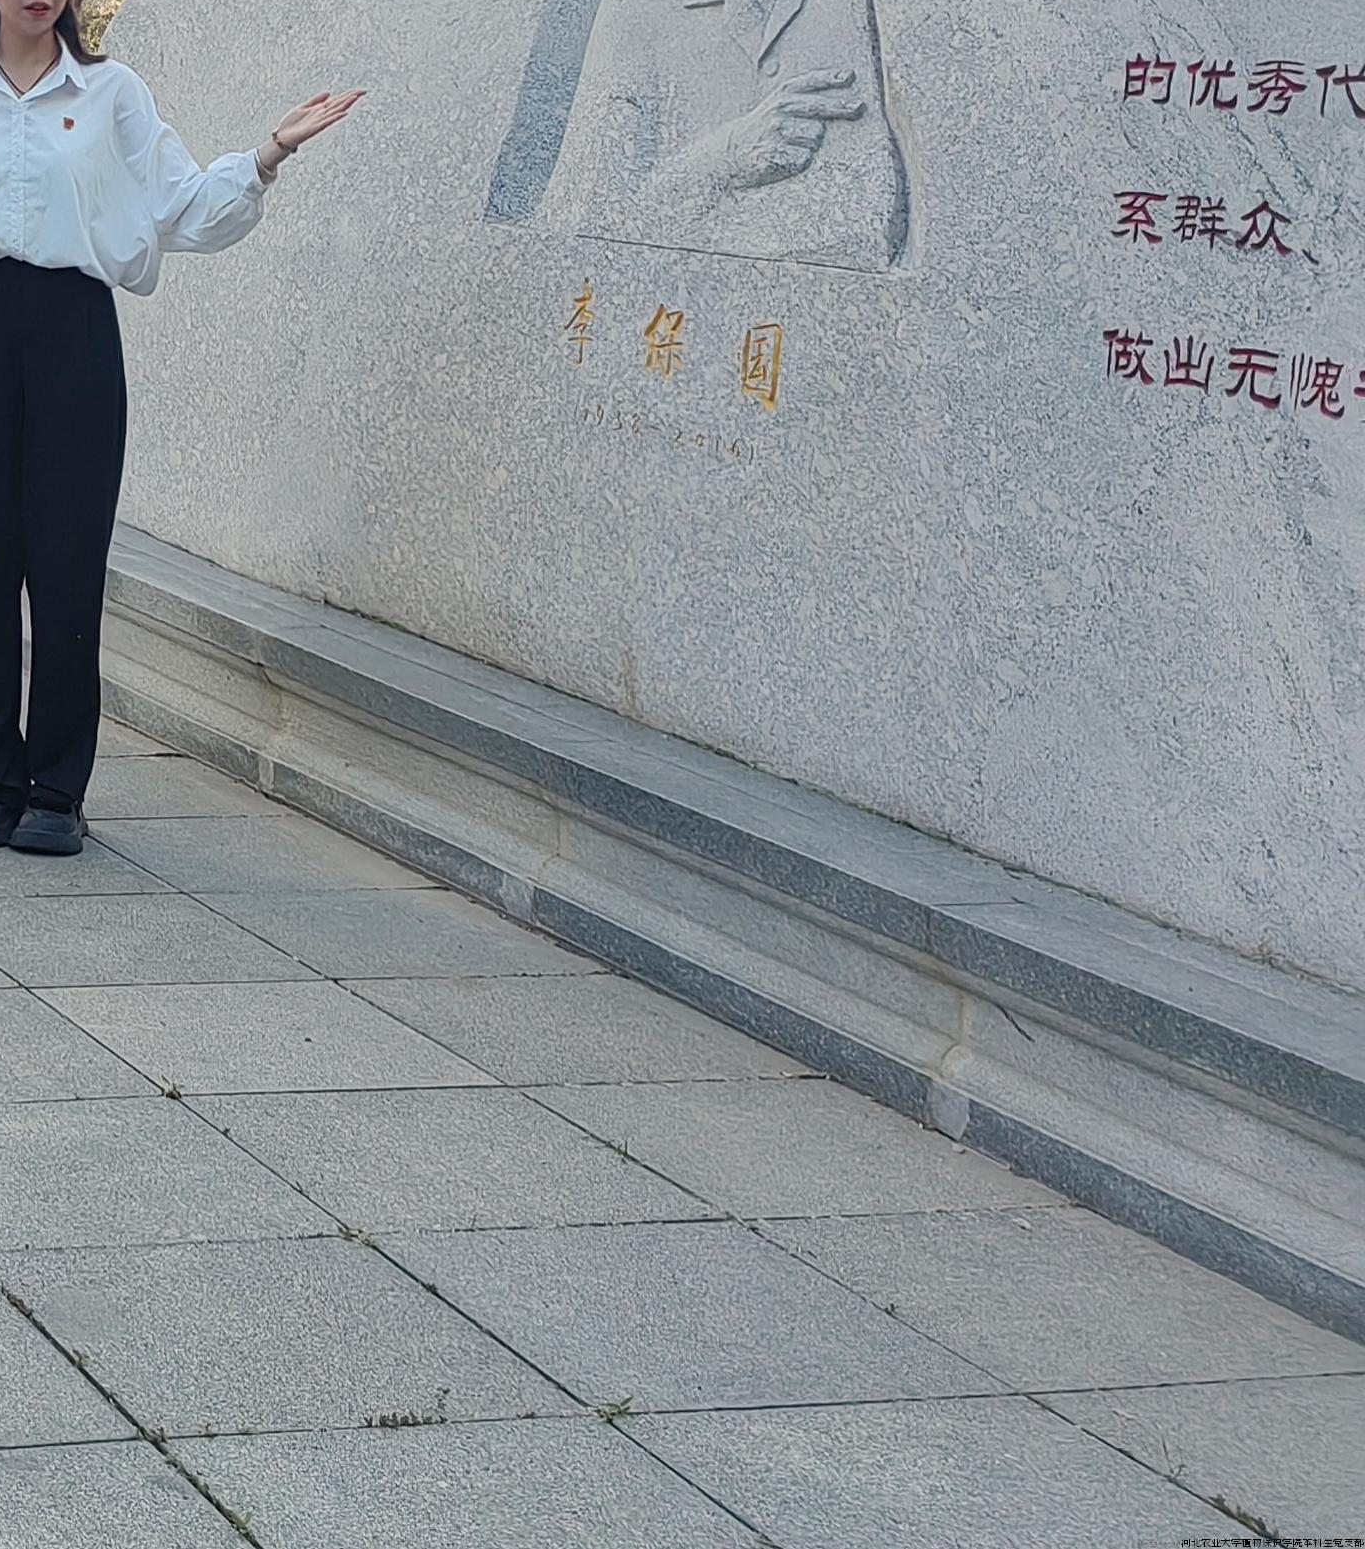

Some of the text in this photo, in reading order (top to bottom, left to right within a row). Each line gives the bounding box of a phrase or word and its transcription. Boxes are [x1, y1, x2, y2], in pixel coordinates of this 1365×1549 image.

[1124, 53, 1365, 119] 的优秀代
[1102, 328, 1365, 420] 做出无愧
